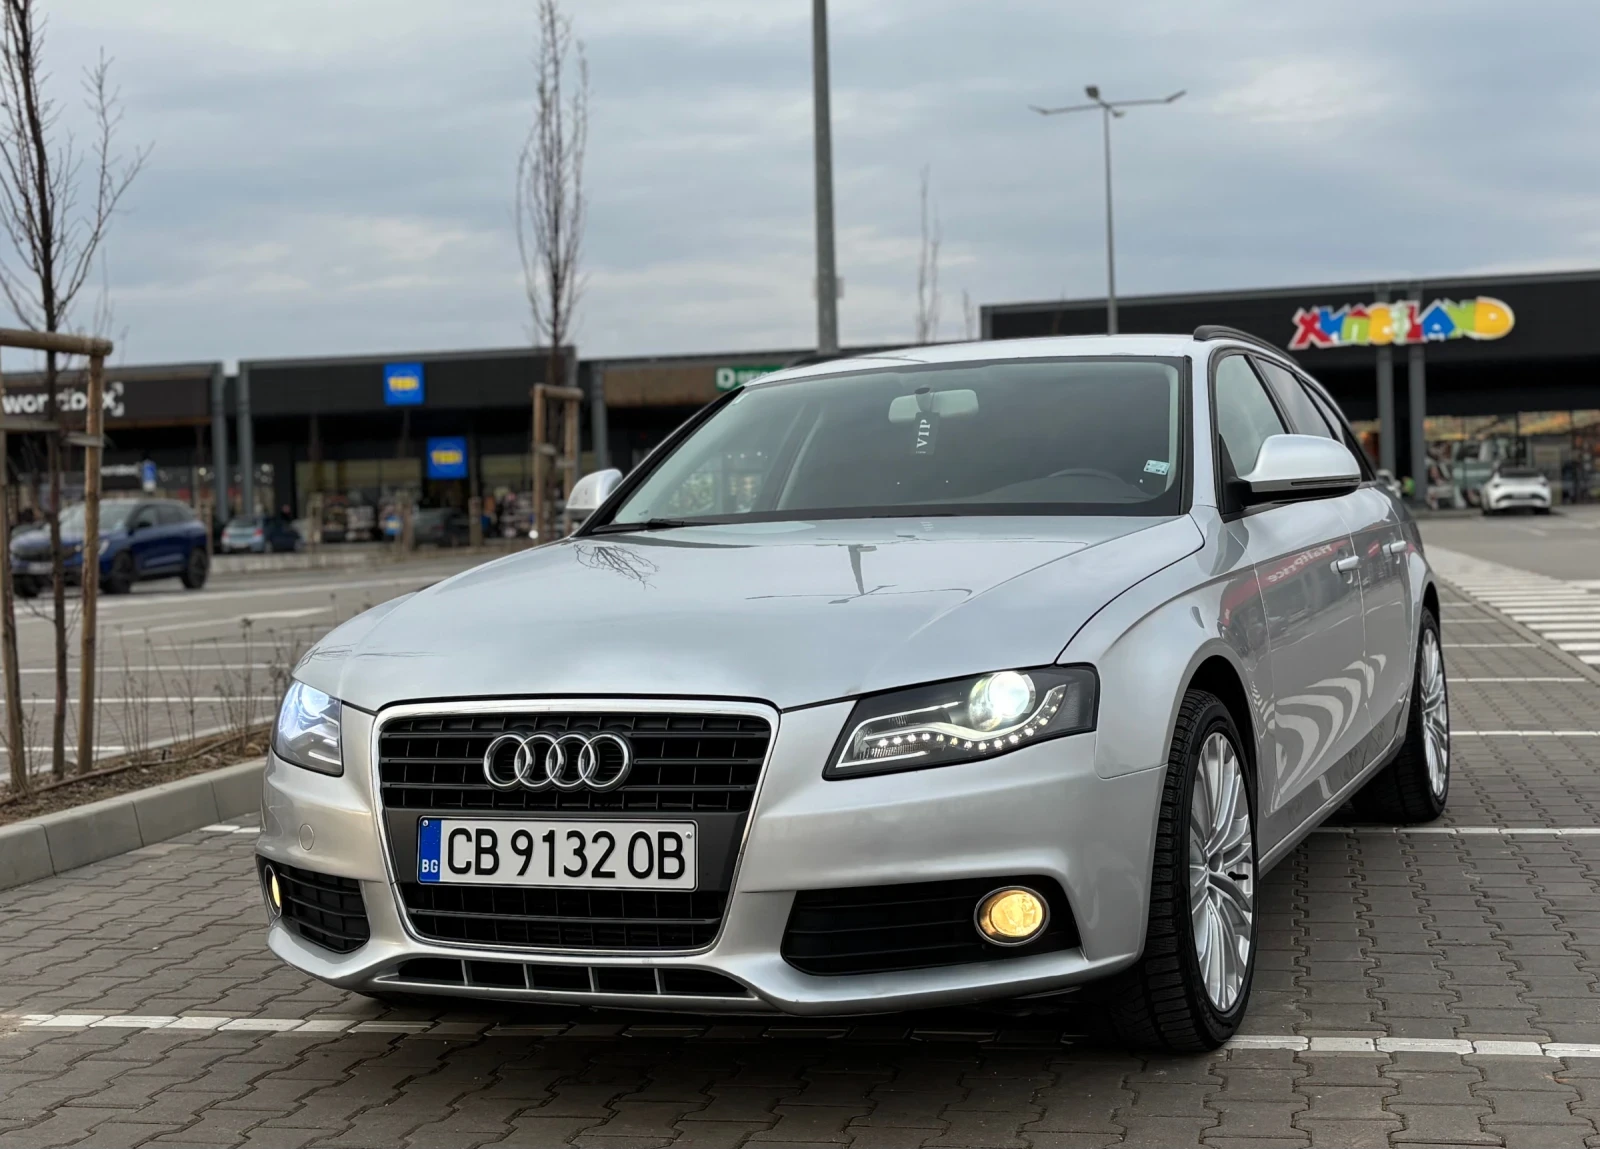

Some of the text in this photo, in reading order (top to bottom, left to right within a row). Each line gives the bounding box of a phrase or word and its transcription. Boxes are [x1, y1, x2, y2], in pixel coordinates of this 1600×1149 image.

[916, 419, 931, 448] VIP
[421, 858, 439, 873] BG
[447, 827, 686, 880] CB 9132 OB
